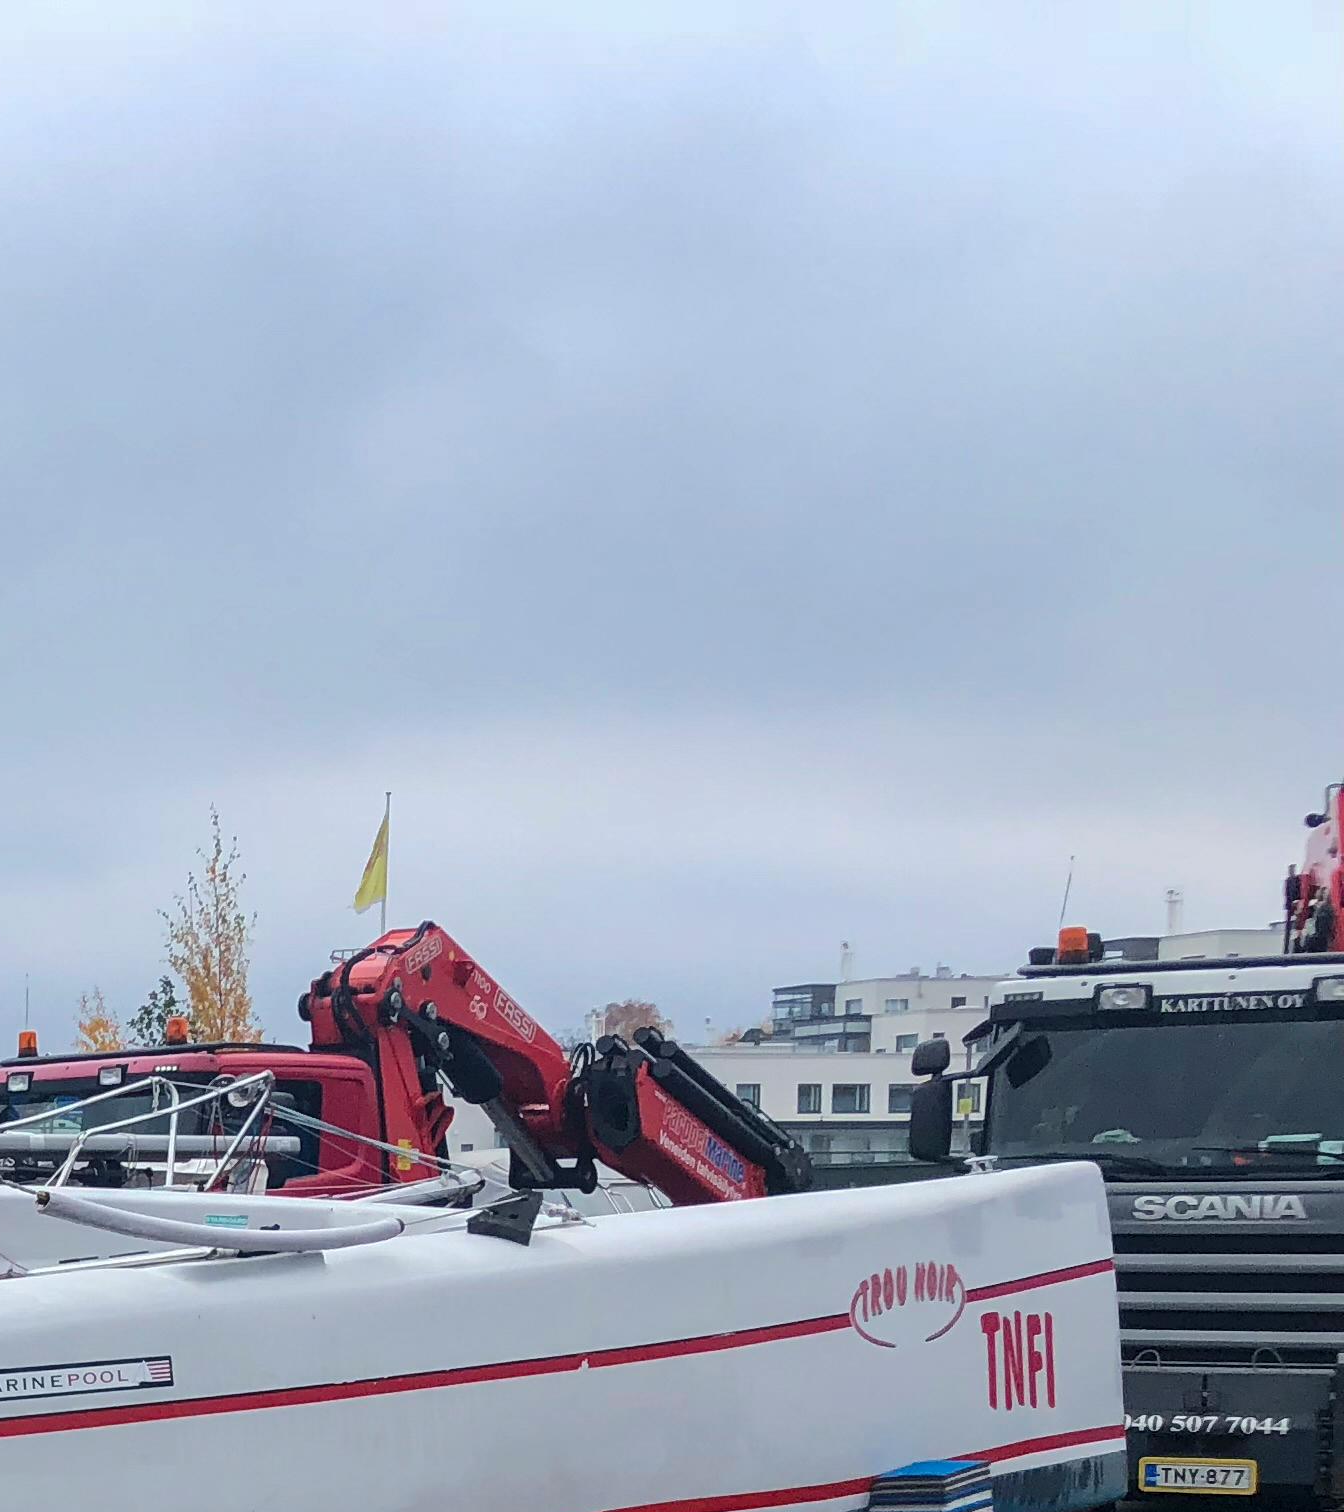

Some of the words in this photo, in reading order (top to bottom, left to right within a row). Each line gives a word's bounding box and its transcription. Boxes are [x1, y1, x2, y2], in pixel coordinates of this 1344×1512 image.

[407, 937, 442, 973] FASSI
[495, 992, 535, 1039] FASSI
[1160, 995, 1275, 1013] KARTTUNEN
[1277, 994, 1307, 1010] OY
[1131, 1194, 1309, 1220] SCANIA
[859, 1264, 908, 1323] TROU
[914, 1260, 957, 1305] NOIR
[980, 1309, 1057, 1411] TNFI
[1169, 1414, 1219, 1433] 507
[1224, 1416, 1291, 1435] 7044
[1161, 1466, 1245, 1487] TNY-877
